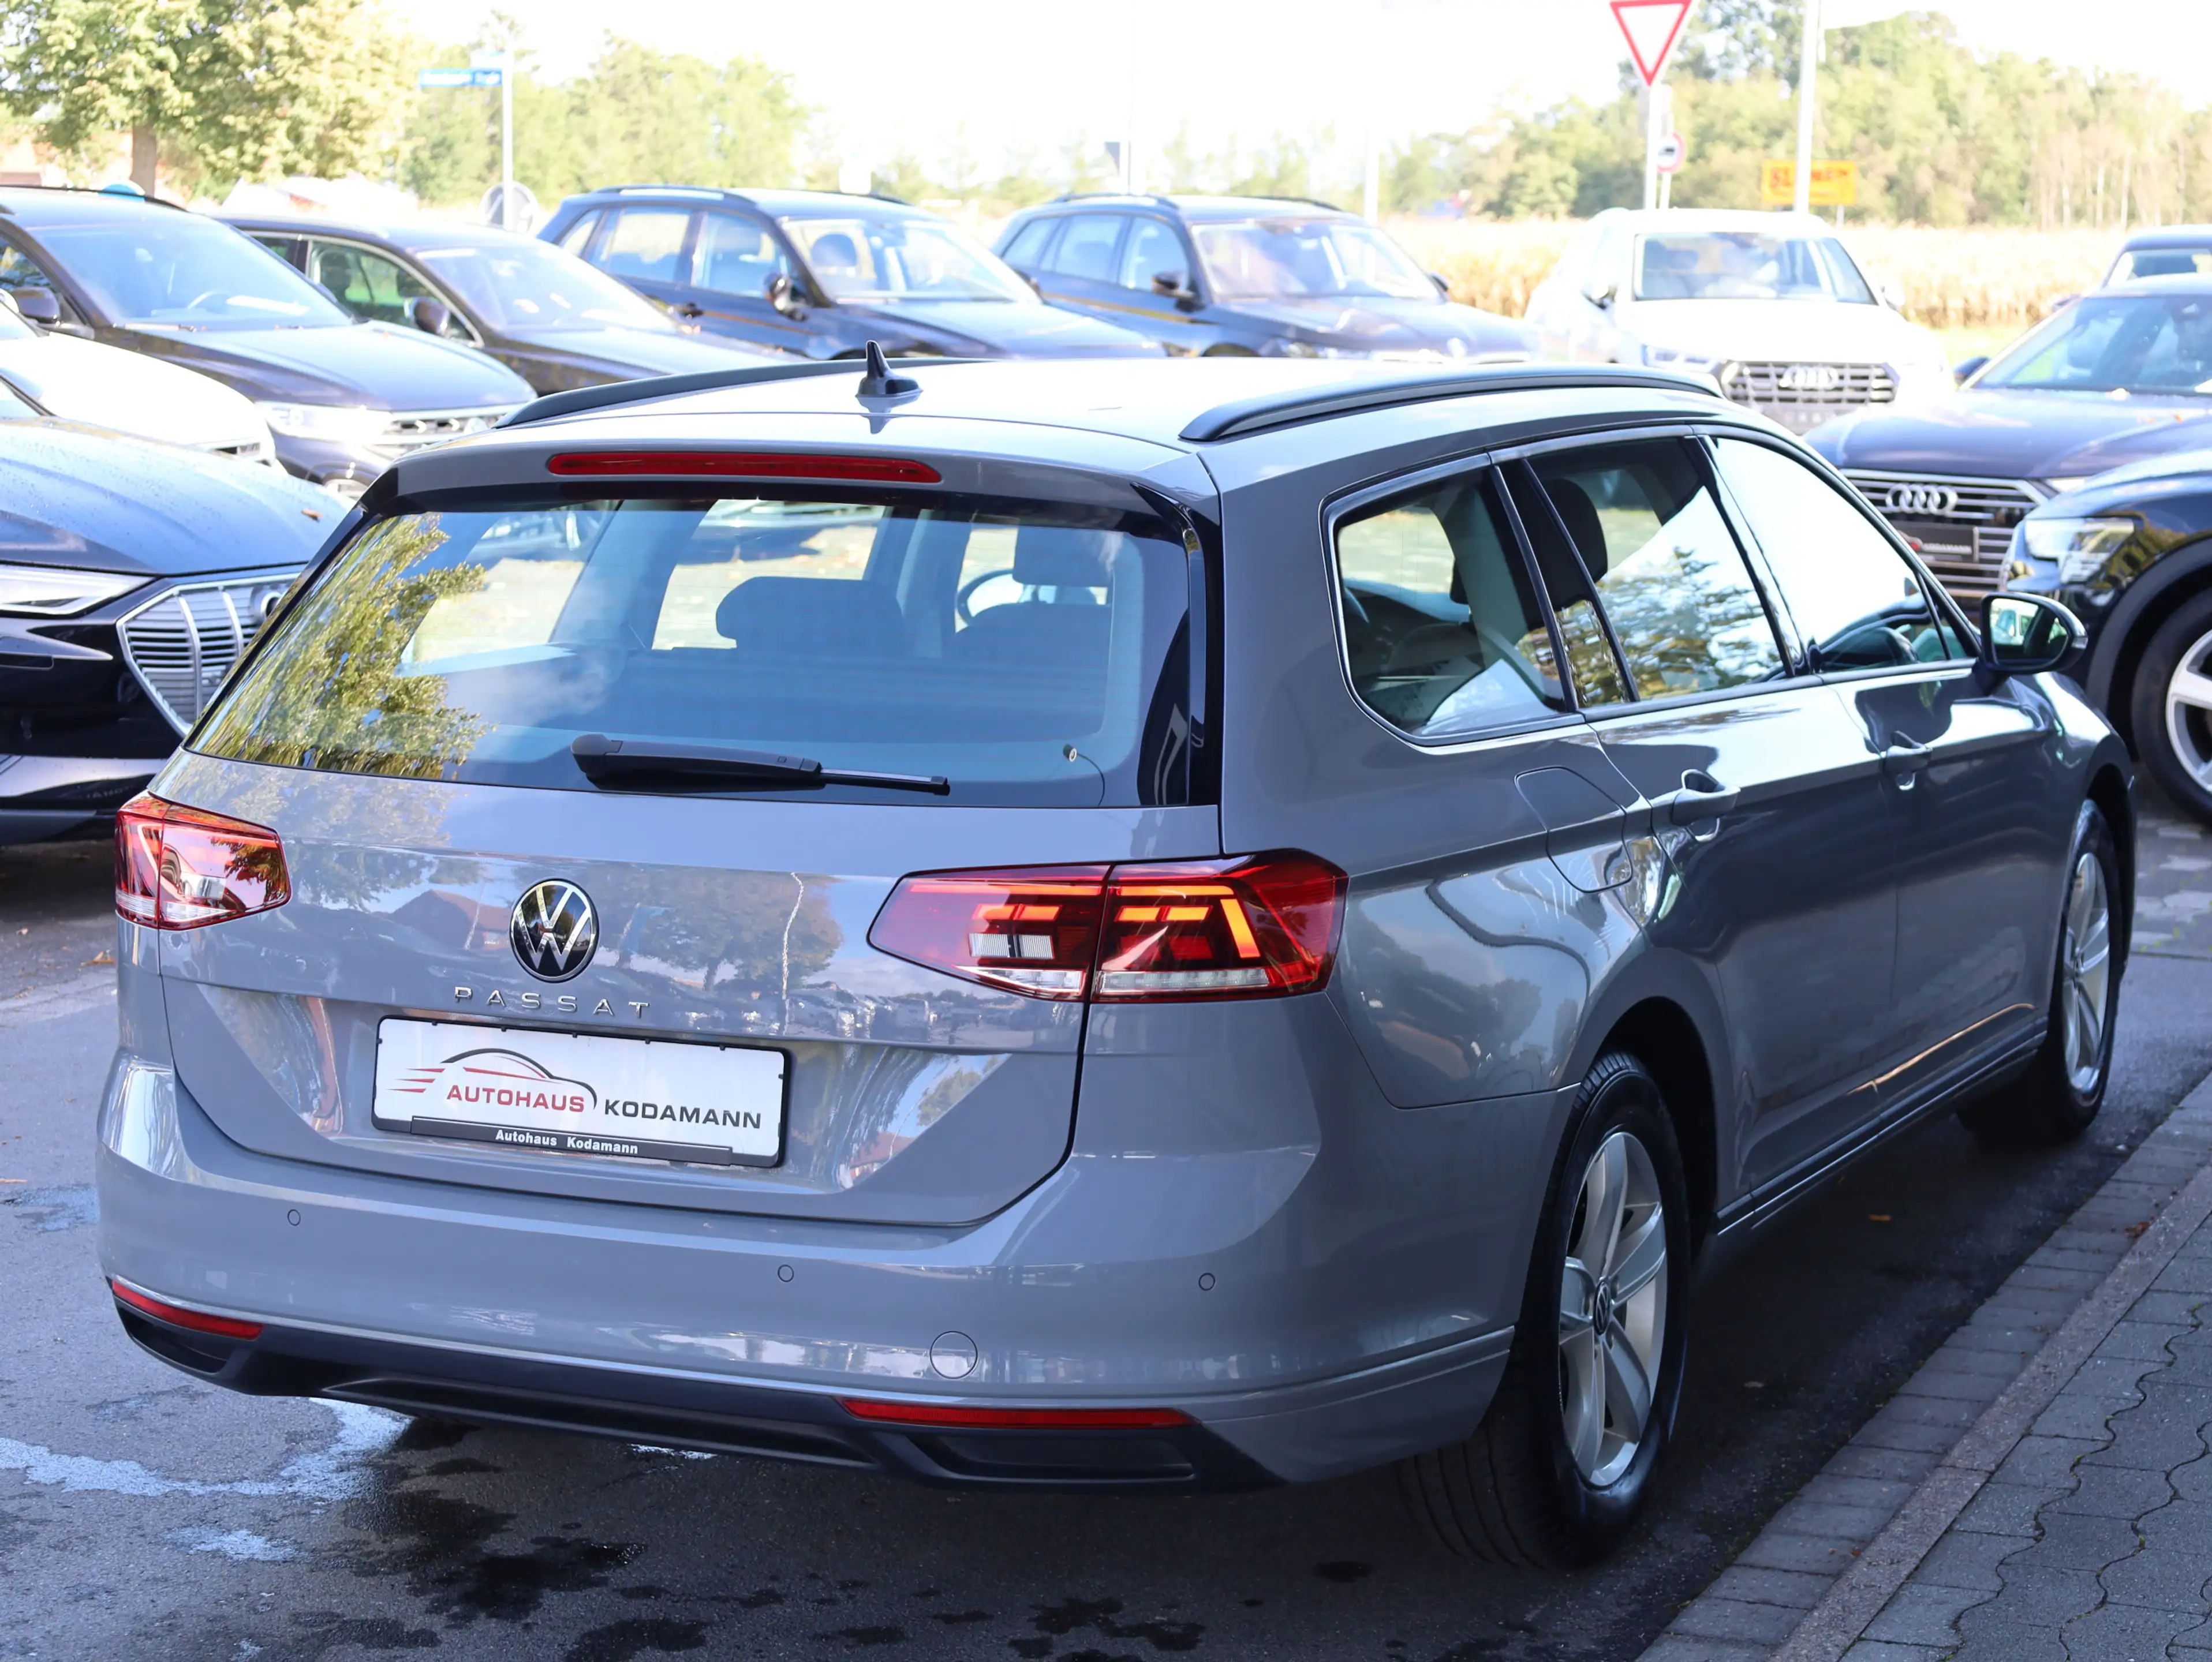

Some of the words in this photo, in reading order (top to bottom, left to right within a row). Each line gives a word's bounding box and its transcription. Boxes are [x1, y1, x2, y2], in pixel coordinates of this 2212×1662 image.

[455, 986, 650, 1019] PASSAT
[446, 1084, 585, 1113] AUTOHAUS
[604, 1099, 761, 1129] KODAMANN
[495, 1129, 557, 1146] Autohaus
[567, 1136, 638, 1155] Kodamann
